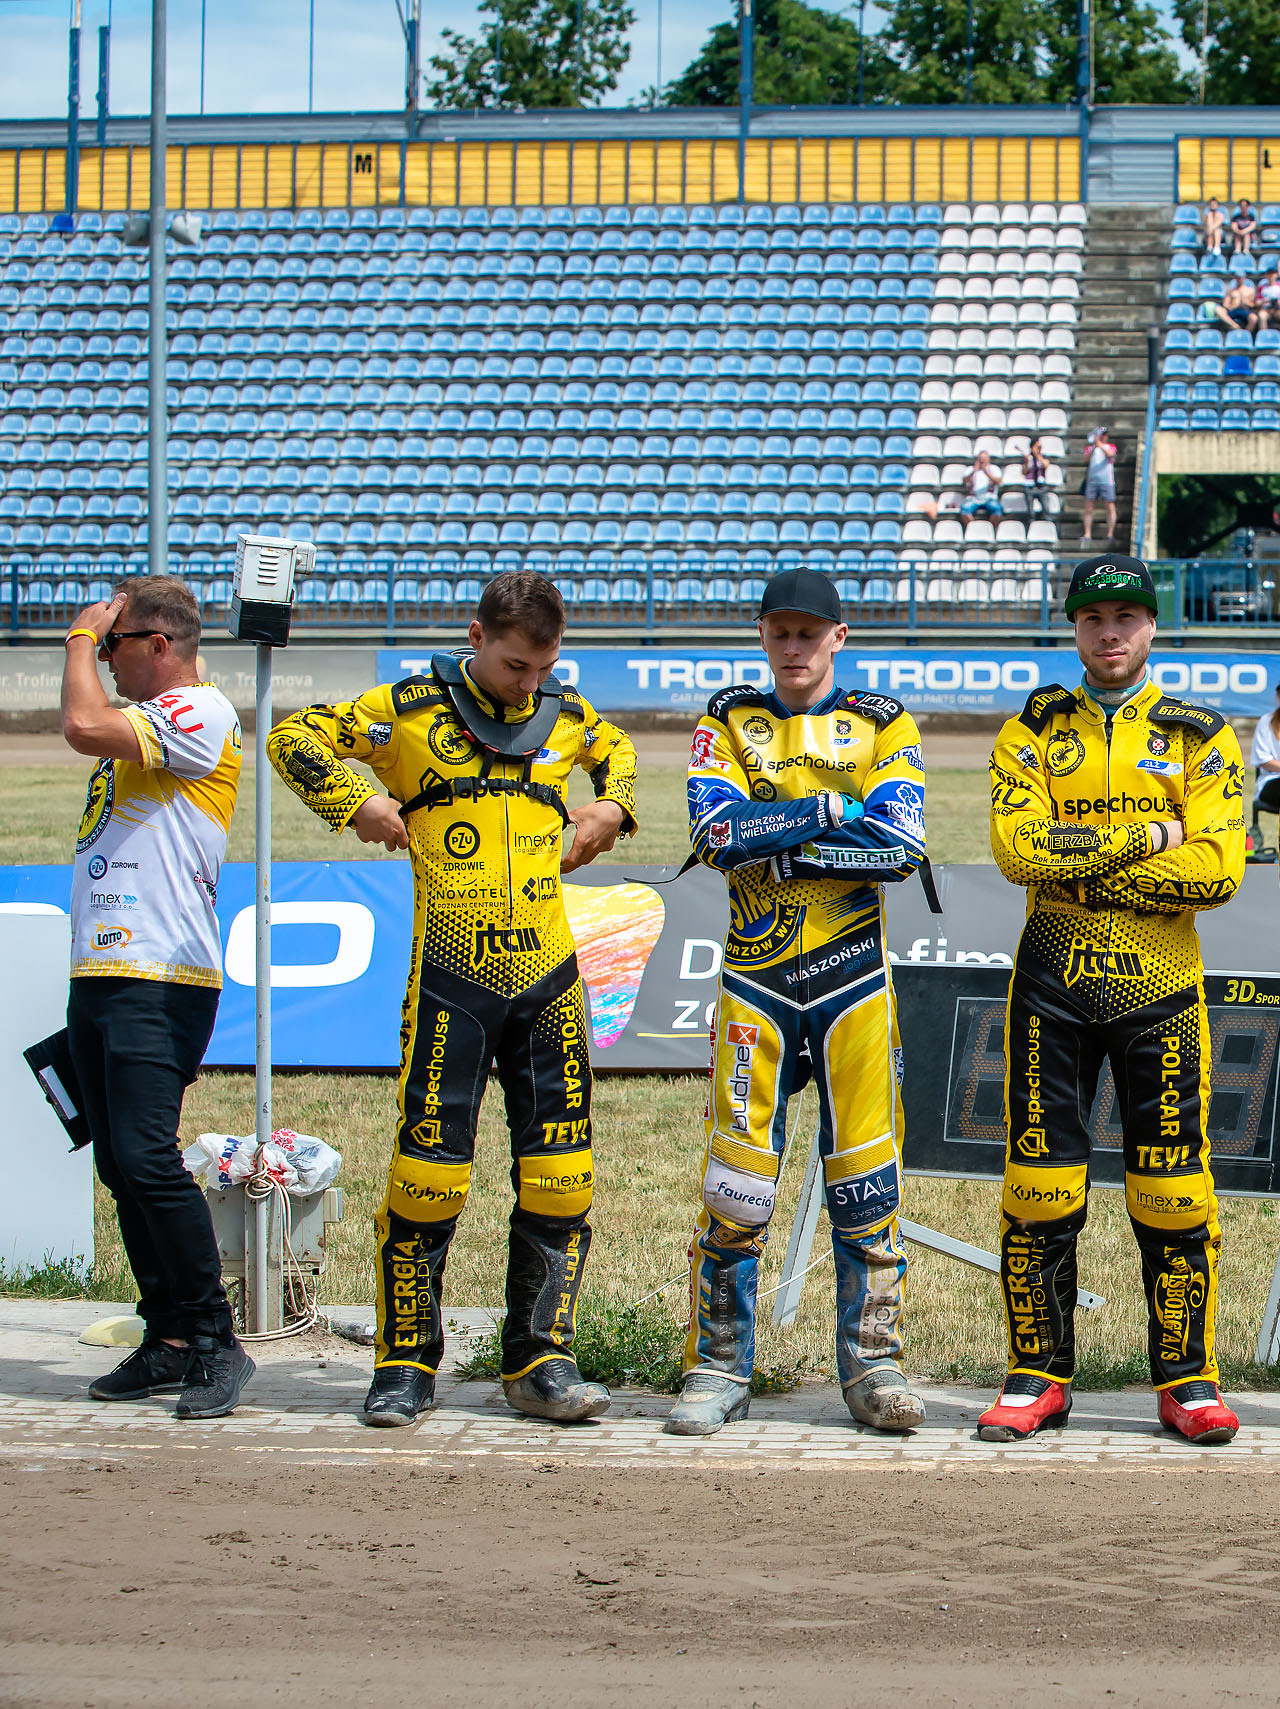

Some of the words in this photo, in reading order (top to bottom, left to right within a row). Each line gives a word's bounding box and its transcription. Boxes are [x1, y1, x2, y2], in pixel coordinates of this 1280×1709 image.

[355, 154, 372, 176] M
[1264, 148, 1272, 170] L
[15, 672, 63, 688] Trofim
[627, 661, 771, 689] TROD
[857, 661, 1040, 691] TRODO
[711, 684, 758, 717] CANAL+
[158, 694, 205, 734] 4U
[1157, 705, 1215, 727] BUDMAR
[277, 749, 337, 796] WIERZBAK
[767, 753, 858, 774] spechouse
[756, 786, 772, 796] PZU
[740, 812, 786, 829] GORZÓW
[452, 833, 473, 848] PZU
[514, 832, 546, 848] Imex
[1031, 834, 1113, 852] WIERZBAK
[442, 861, 485, 872] ZDROWIE
[834, 847, 906, 864] TUSCHE
[1032, 853, 1049, 864] Rok
[1091, 849, 1113, 861] 1990
[92, 861, 104, 873] PZU
[110, 861, 140, 870] ZDROWIE
[90, 891, 121, 904] Imex
[436, 888, 507, 900] NOVOTEL
[1134, 878, 1237, 900] SALVA
[469, 901, 505, 909] CENTRUM
[97, 930, 123, 946] LOTTO
[726, 939, 773, 957] ORZÓW
[774, 906, 797, 939] WLK
[785, 937, 876, 985] MASZOŃSKI
[1223, 979, 1256, 1003] 3D
[424, 1010, 450, 1116] spechouse
[560, 1004, 583, 1110] POL-CAR
[732, 1027, 753, 1132] budnex
[1025, 1015, 1045, 1124] spechouse
[1160, 1036, 1181, 1137] POL-CAR
[1136, 1145, 1190, 1171] TEY!
[540, 1173, 580, 1187] Imex
[834, 1175, 895, 1206] STAL
[717, 1181, 772, 1208] faurecia
[1011, 1183, 1070, 1203] Kubota
[1136, 1188, 1175, 1207] Imex
[850, 1202, 892, 1220] SYSTEM
[393, 1239, 419, 1348] ENERGIA
